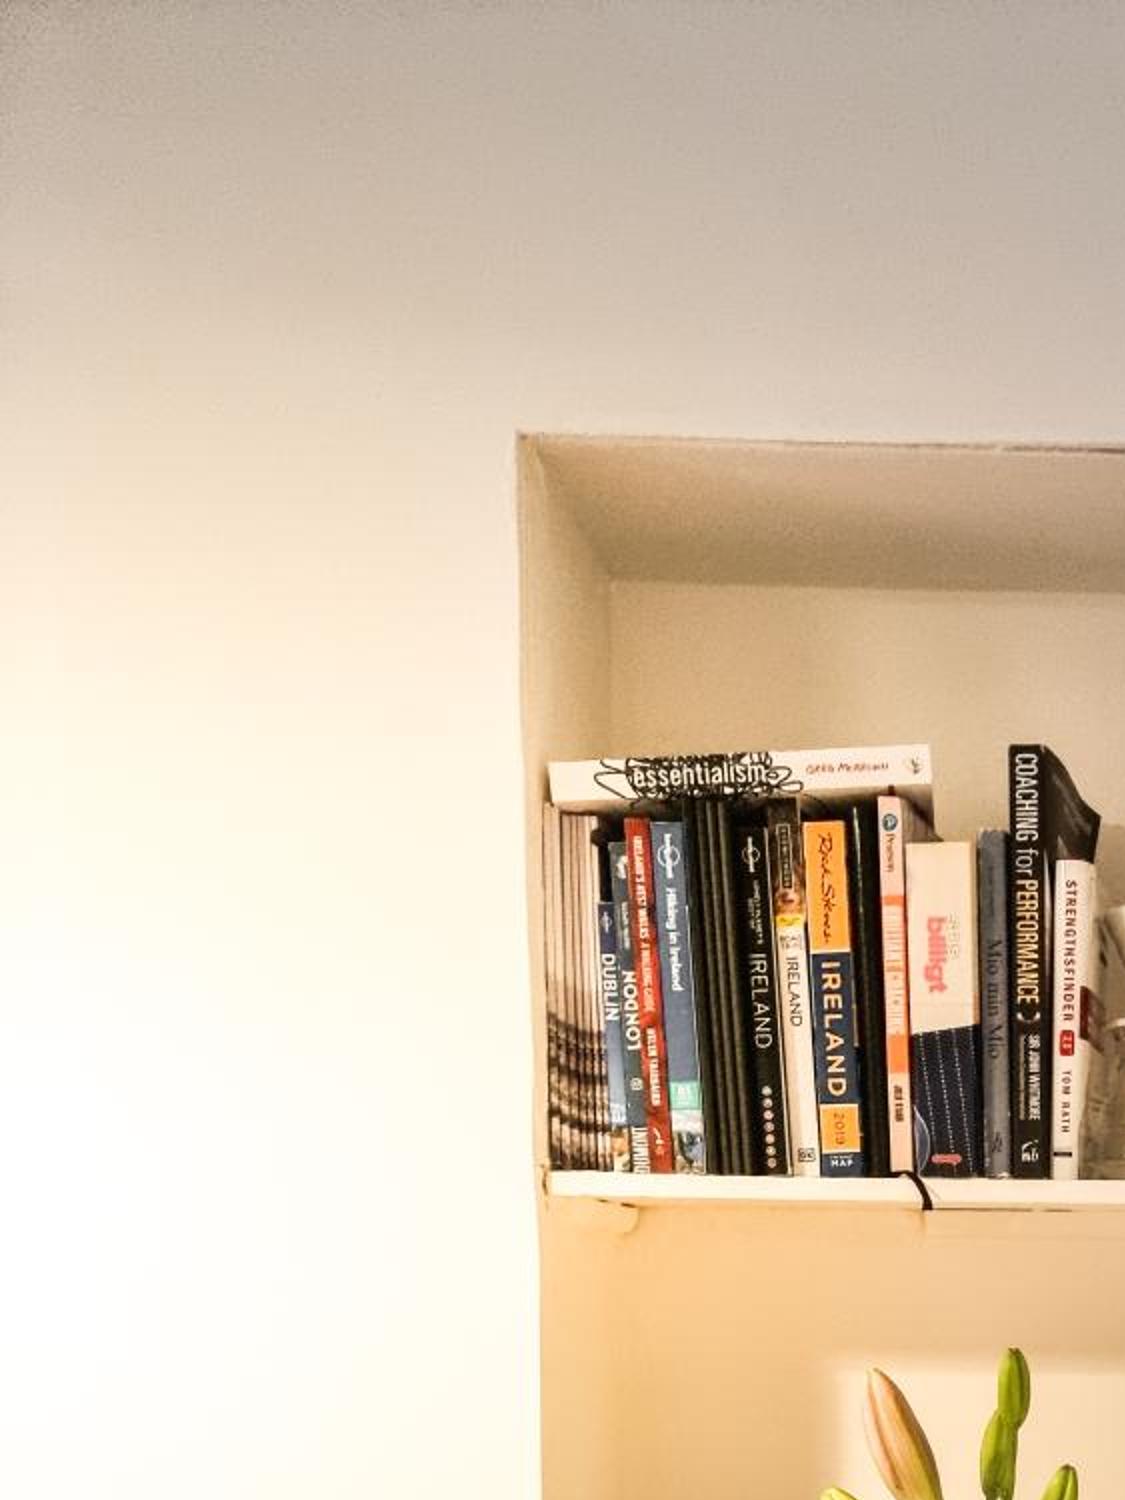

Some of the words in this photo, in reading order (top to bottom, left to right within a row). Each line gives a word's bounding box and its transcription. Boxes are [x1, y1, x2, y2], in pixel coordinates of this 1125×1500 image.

[632, 763, 768, 789] essentialism
[1014, 752, 1040, 840] COACHING
[1016, 847, 1040, 876] for
[664, 886, 683, 929] Hiking
[669, 931, 681, 944] in
[924, 914, 948, 994] billigt
[1014, 879, 1041, 1004] PERFORMANCE
[1063, 879, 1078, 1022] STRENGTHSFINDER
[601, 952, 620, 1022] DUBLIN
[670, 947, 685, 992] Ireland
[785, 955, 803, 1027] IRELAND
[624, 969, 640, 1051] LONDON
[748, 952, 773, 1050] IRELAND
[820, 960, 848, 1098] IRELAND
[1061, 1069, 1072, 1096] TOM
[833, 1111, 847, 1147] 2019
[1060, 1101, 1072, 1134] RATH
[631, 1126, 650, 1174] DUMONT
[831, 1159, 854, 1167] MAP
